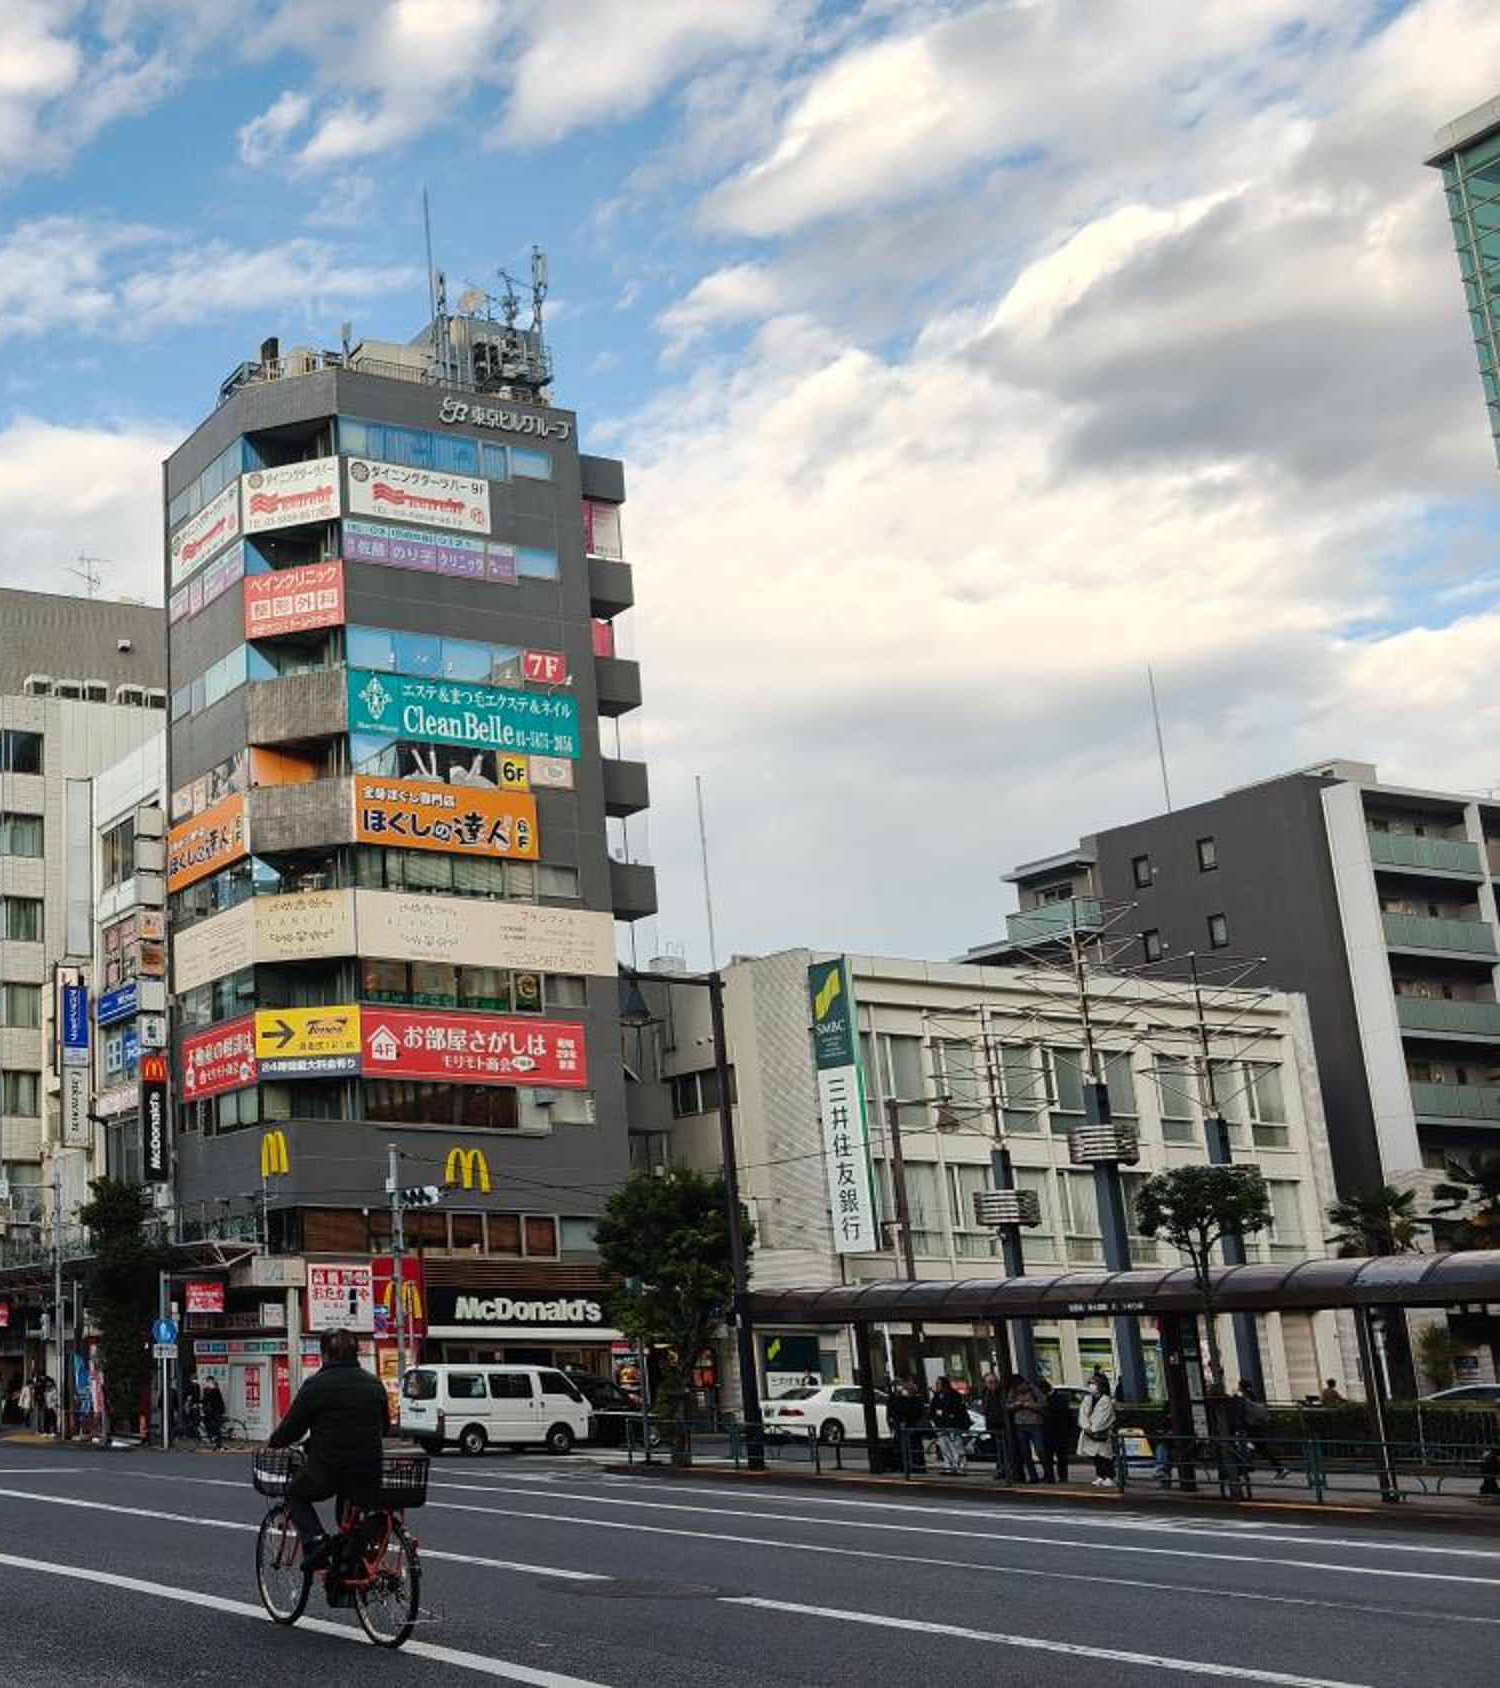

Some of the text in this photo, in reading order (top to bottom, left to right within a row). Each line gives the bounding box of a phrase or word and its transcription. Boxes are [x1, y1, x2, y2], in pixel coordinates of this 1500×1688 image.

[528, 654, 560, 677] 7F
[503, 762, 525, 782] 6F
[363, 809, 510, 846] ほぐしの達人
[403, 1025, 547, 1057] お部屋さがしは
[816, 1019, 846, 1037] SMBC
[149, 1091, 162, 1170] McDonald's
[827, 1078, 861, 1241] 三井住友銀行
[454, 1295, 602, 1322] McDonald's
